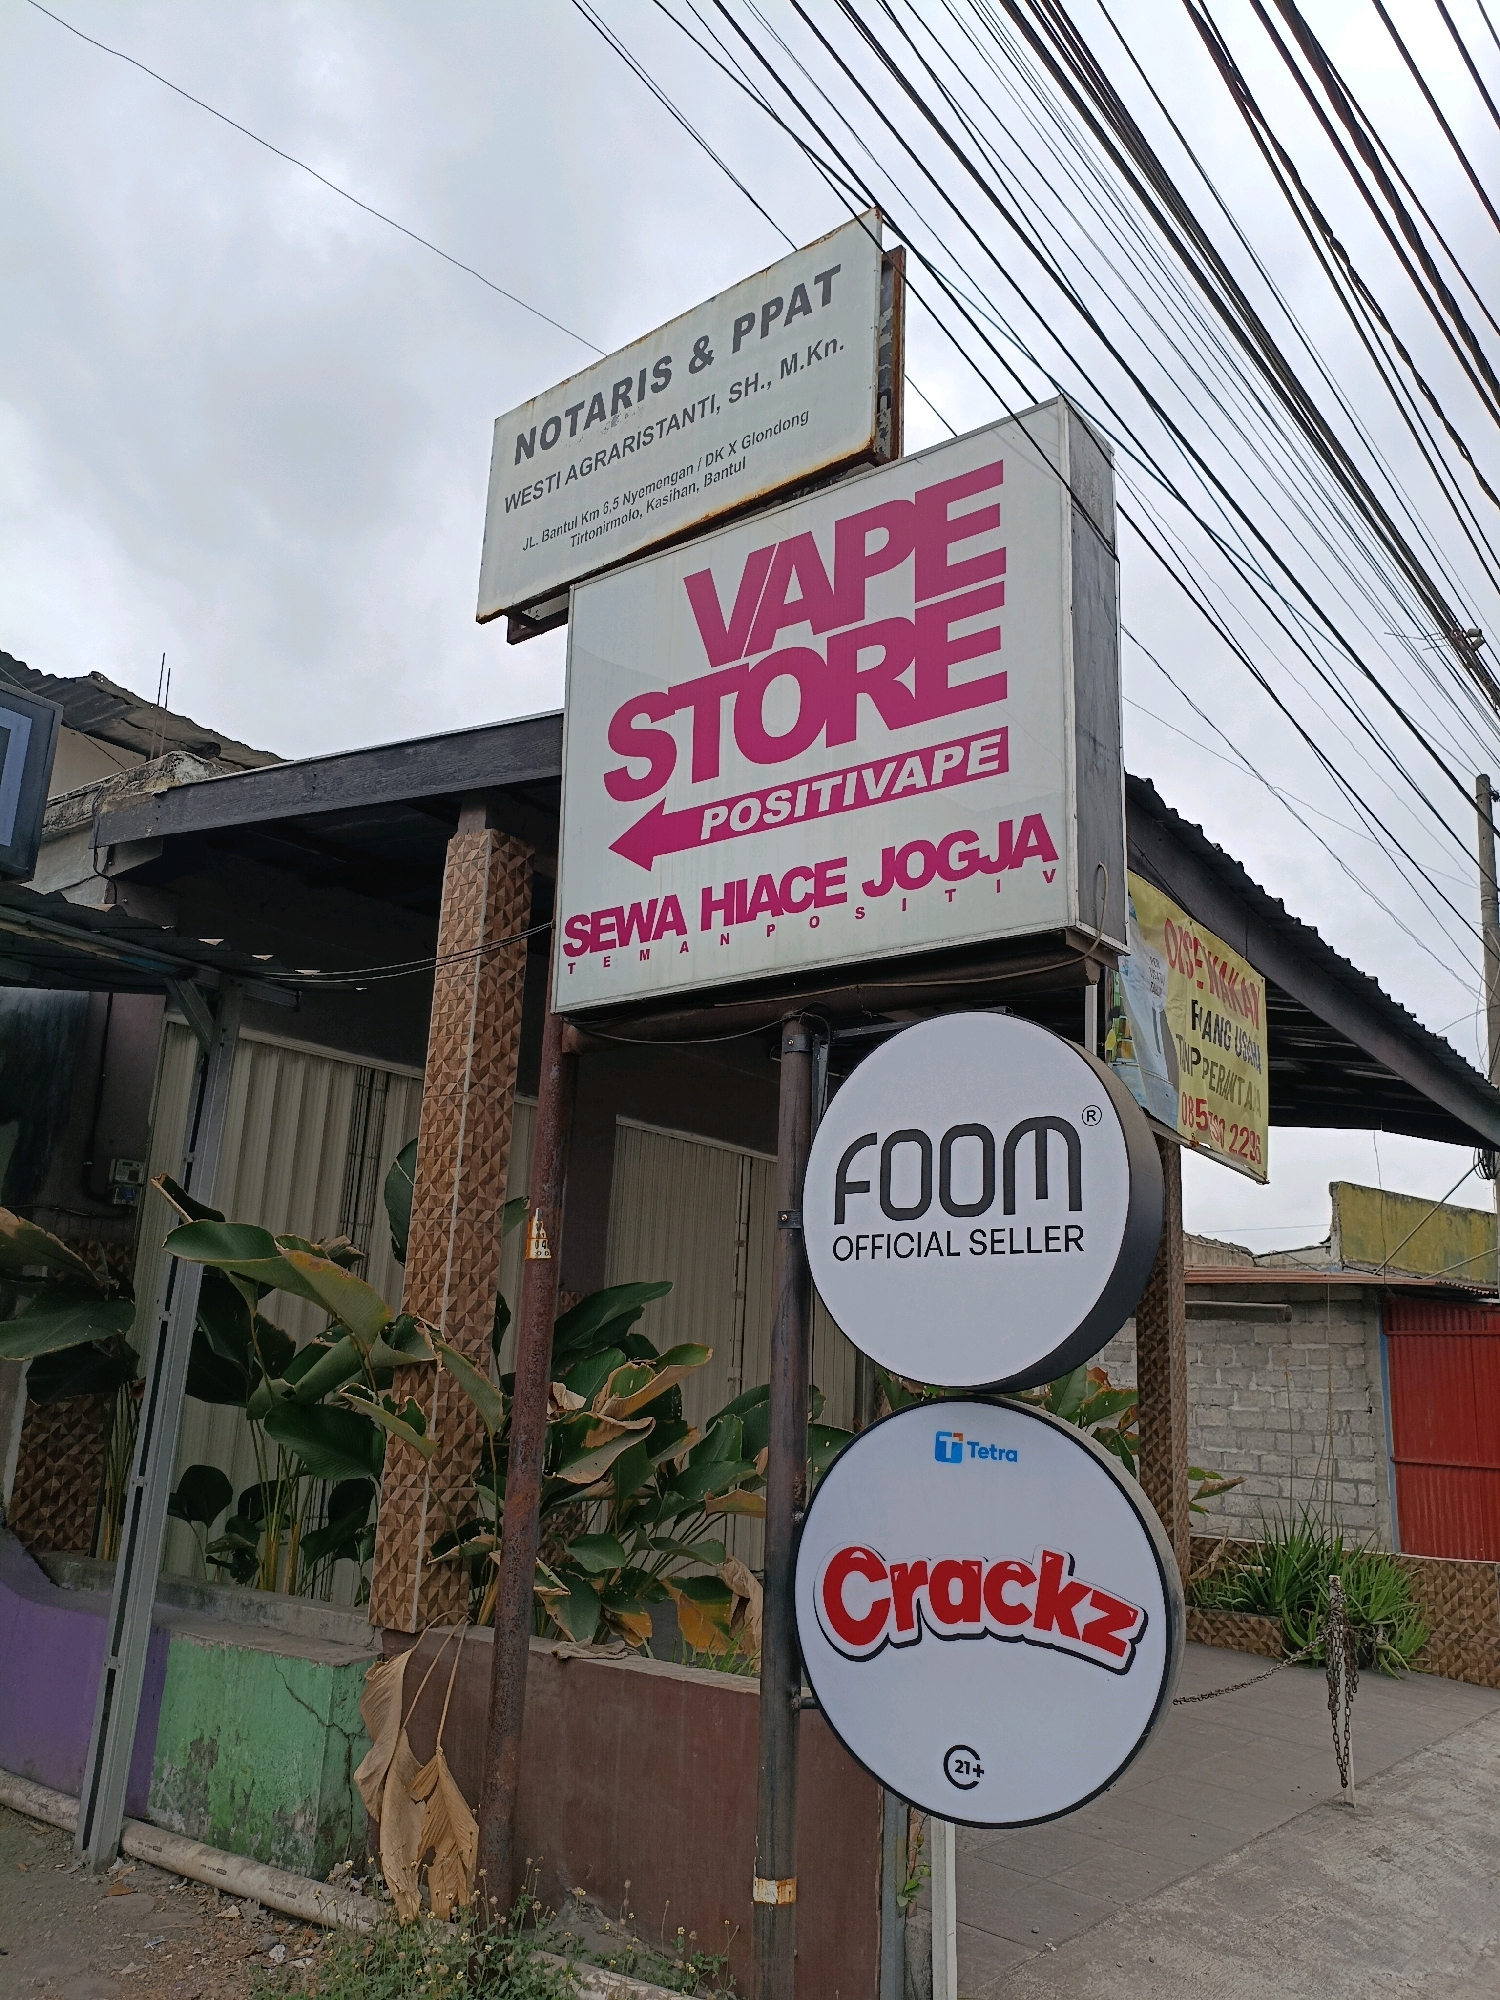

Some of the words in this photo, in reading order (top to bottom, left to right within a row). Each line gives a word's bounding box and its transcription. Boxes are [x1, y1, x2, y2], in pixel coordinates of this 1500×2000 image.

[514, 355, 672, 465] NOTARIS
[688, 334, 714, 374] &
[732, 263, 841, 354] PPAT
[504, 471, 561, 513] WESTI
[565, 394, 721, 485] AGRARISTANTI,
[728, 372, 772, 403] SH.,
[780, 338, 844, 379] M.Kn.
[542, 515, 578, 543] Bantul
[581, 508, 600, 525] Km
[603, 497, 619, 515] 6,5
[623, 464, 694, 506] Nyemengan
[705, 447, 724, 468] DK
[728, 440, 738, 457] X
[741, 410, 809, 449] Glondong
[571, 508, 642, 548] Tirtonirmolo,
[646, 483, 699, 514] Kasihan,
[704, 456, 746, 487] Bantul
[683, 459, 1007, 668] VAPE
[603, 580, 1008, 802] STORE
[701, 733, 1002, 841] POSITIVAPE
[563, 895, 687, 958] SEWA
[701, 857, 848, 931] HIACE
[861, 812, 1059, 898] JOGJA
[833, 1115, 1083, 1226] FOOM
[832, 1230, 961, 1262] OFFICIAL
[969, 1224, 1085, 1256] SELLER
[967, 1440, 1018, 1463] Tetra
[821, 1545, 1140, 1659] Crackz
[953, 1758, 985, 1779] 21+
